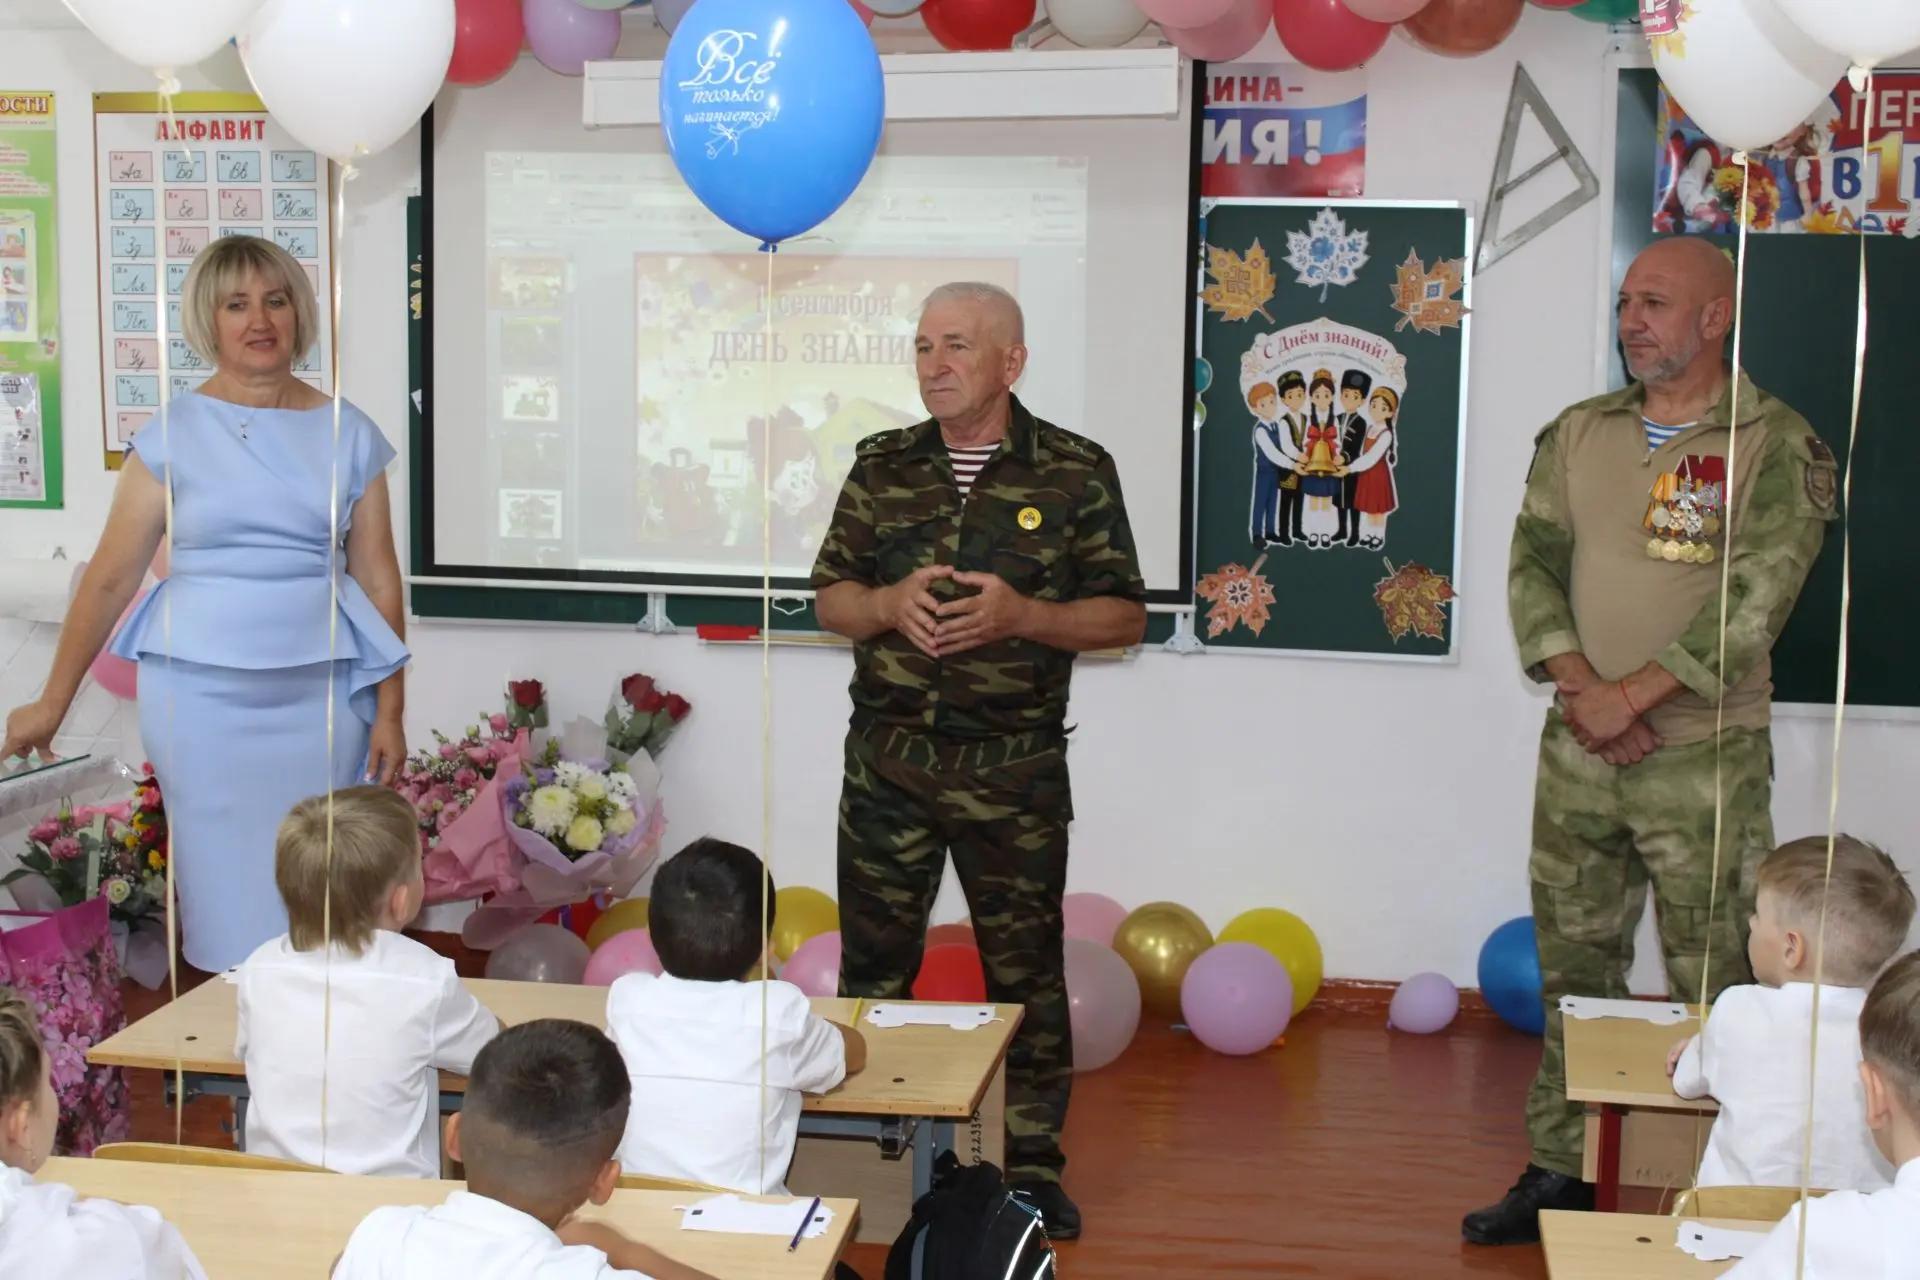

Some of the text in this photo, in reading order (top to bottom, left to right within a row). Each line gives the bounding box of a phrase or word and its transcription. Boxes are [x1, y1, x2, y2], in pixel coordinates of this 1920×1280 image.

[693, 85, 764, 104] только
[1205, 76, 1303, 105] ИНА-
[156, 119, 266, 140] АЛФАВИТ
[709, 331, 788, 369] ДЕНЬ
[1278, 329, 1320, 355] Днём
[1323, 331, 1389, 362] знаний!
